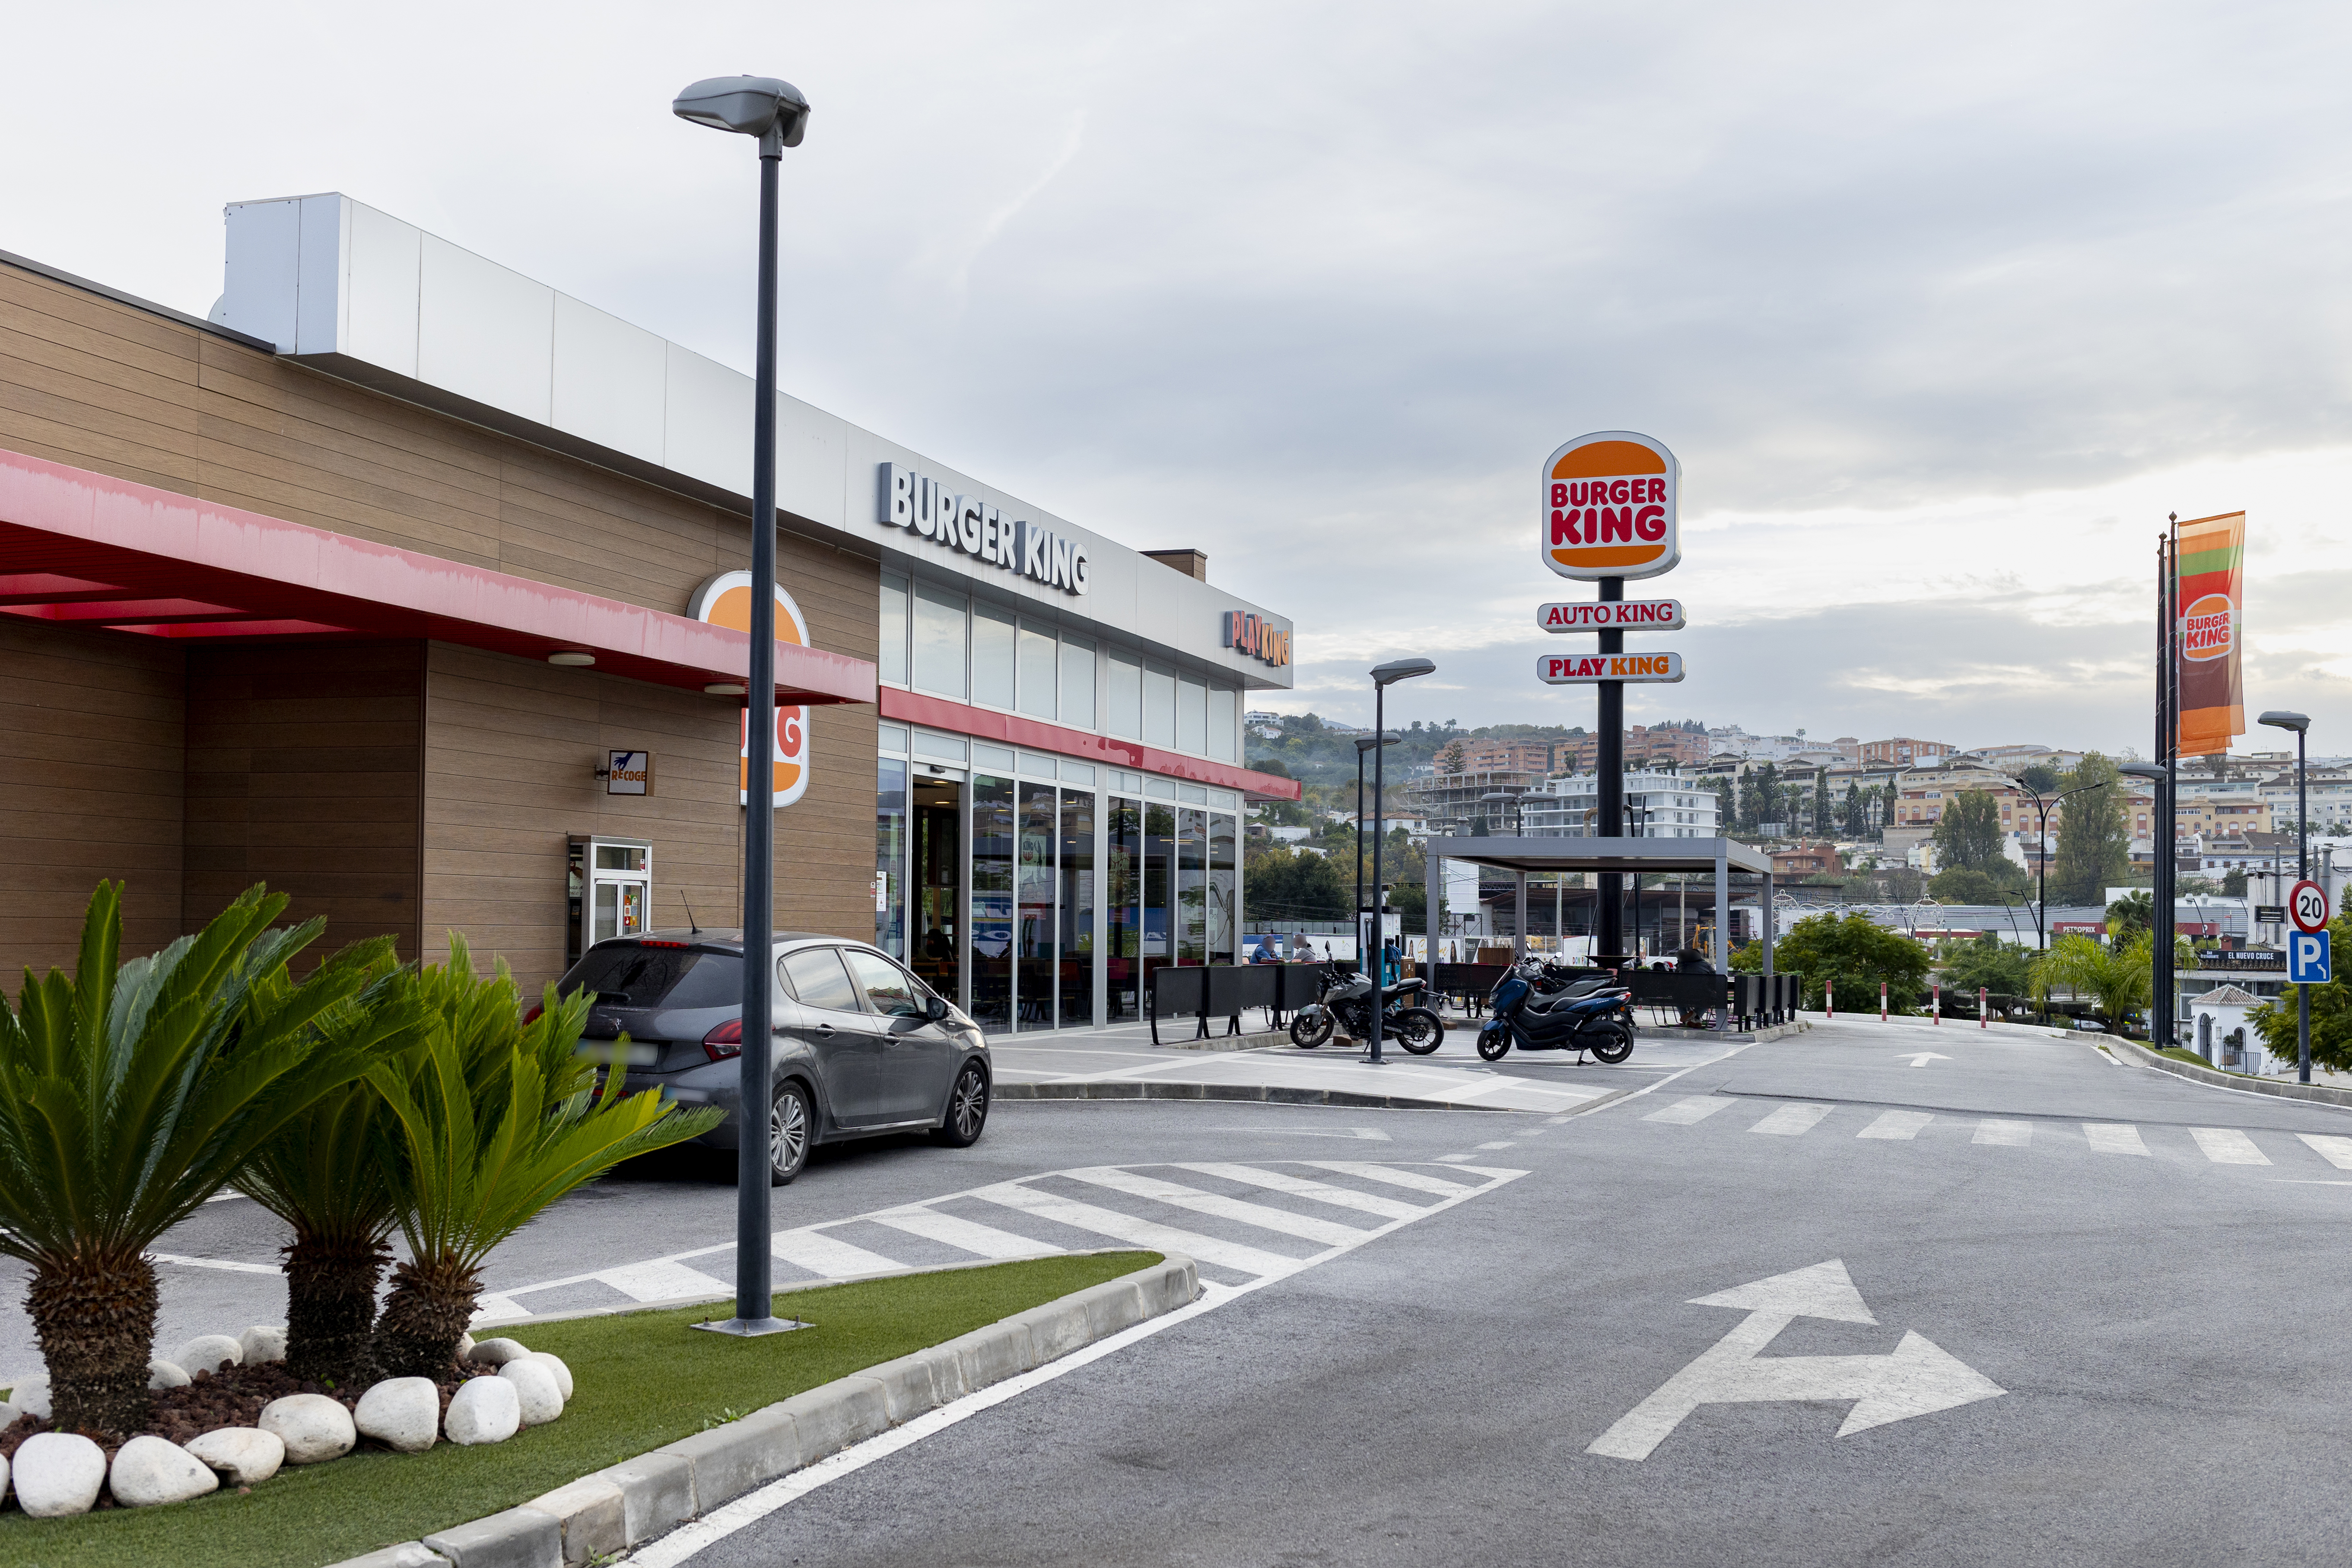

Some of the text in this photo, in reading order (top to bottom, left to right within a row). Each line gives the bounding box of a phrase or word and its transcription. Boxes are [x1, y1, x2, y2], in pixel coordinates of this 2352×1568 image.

[1551, 478, 1666, 508] BURGER
[888, 462, 1089, 596] BURGER KING
[1551, 505, 1666, 545] KING
[1546, 603, 1673, 625] AUTO KING
[2187, 612, 2231, 631] BURGER
[1232, 610, 1289, 667] PLAY KING
[2186, 626, 2231, 649] KING
[1549, 656, 1669, 677] PLAY KING
[611, 769, 645, 782] RECOGE
[2300, 895, 2322, 919] 20
[2298, 937, 2321, 976] P
